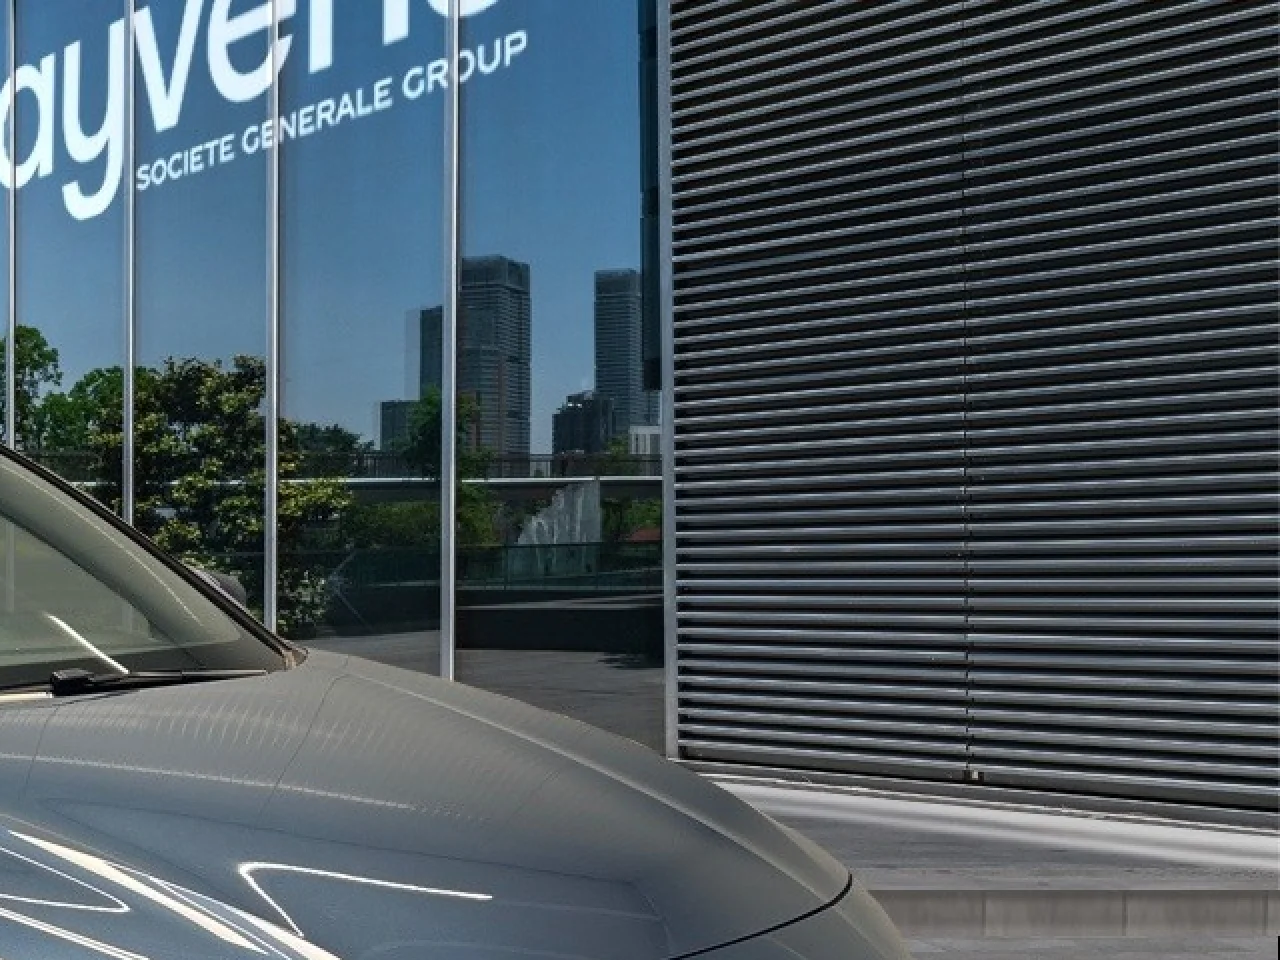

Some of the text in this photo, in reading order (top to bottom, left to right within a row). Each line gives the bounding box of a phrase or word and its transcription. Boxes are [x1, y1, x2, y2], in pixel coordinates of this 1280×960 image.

[136, 30, 528, 190] SOCIETE GENERALE GROUP
